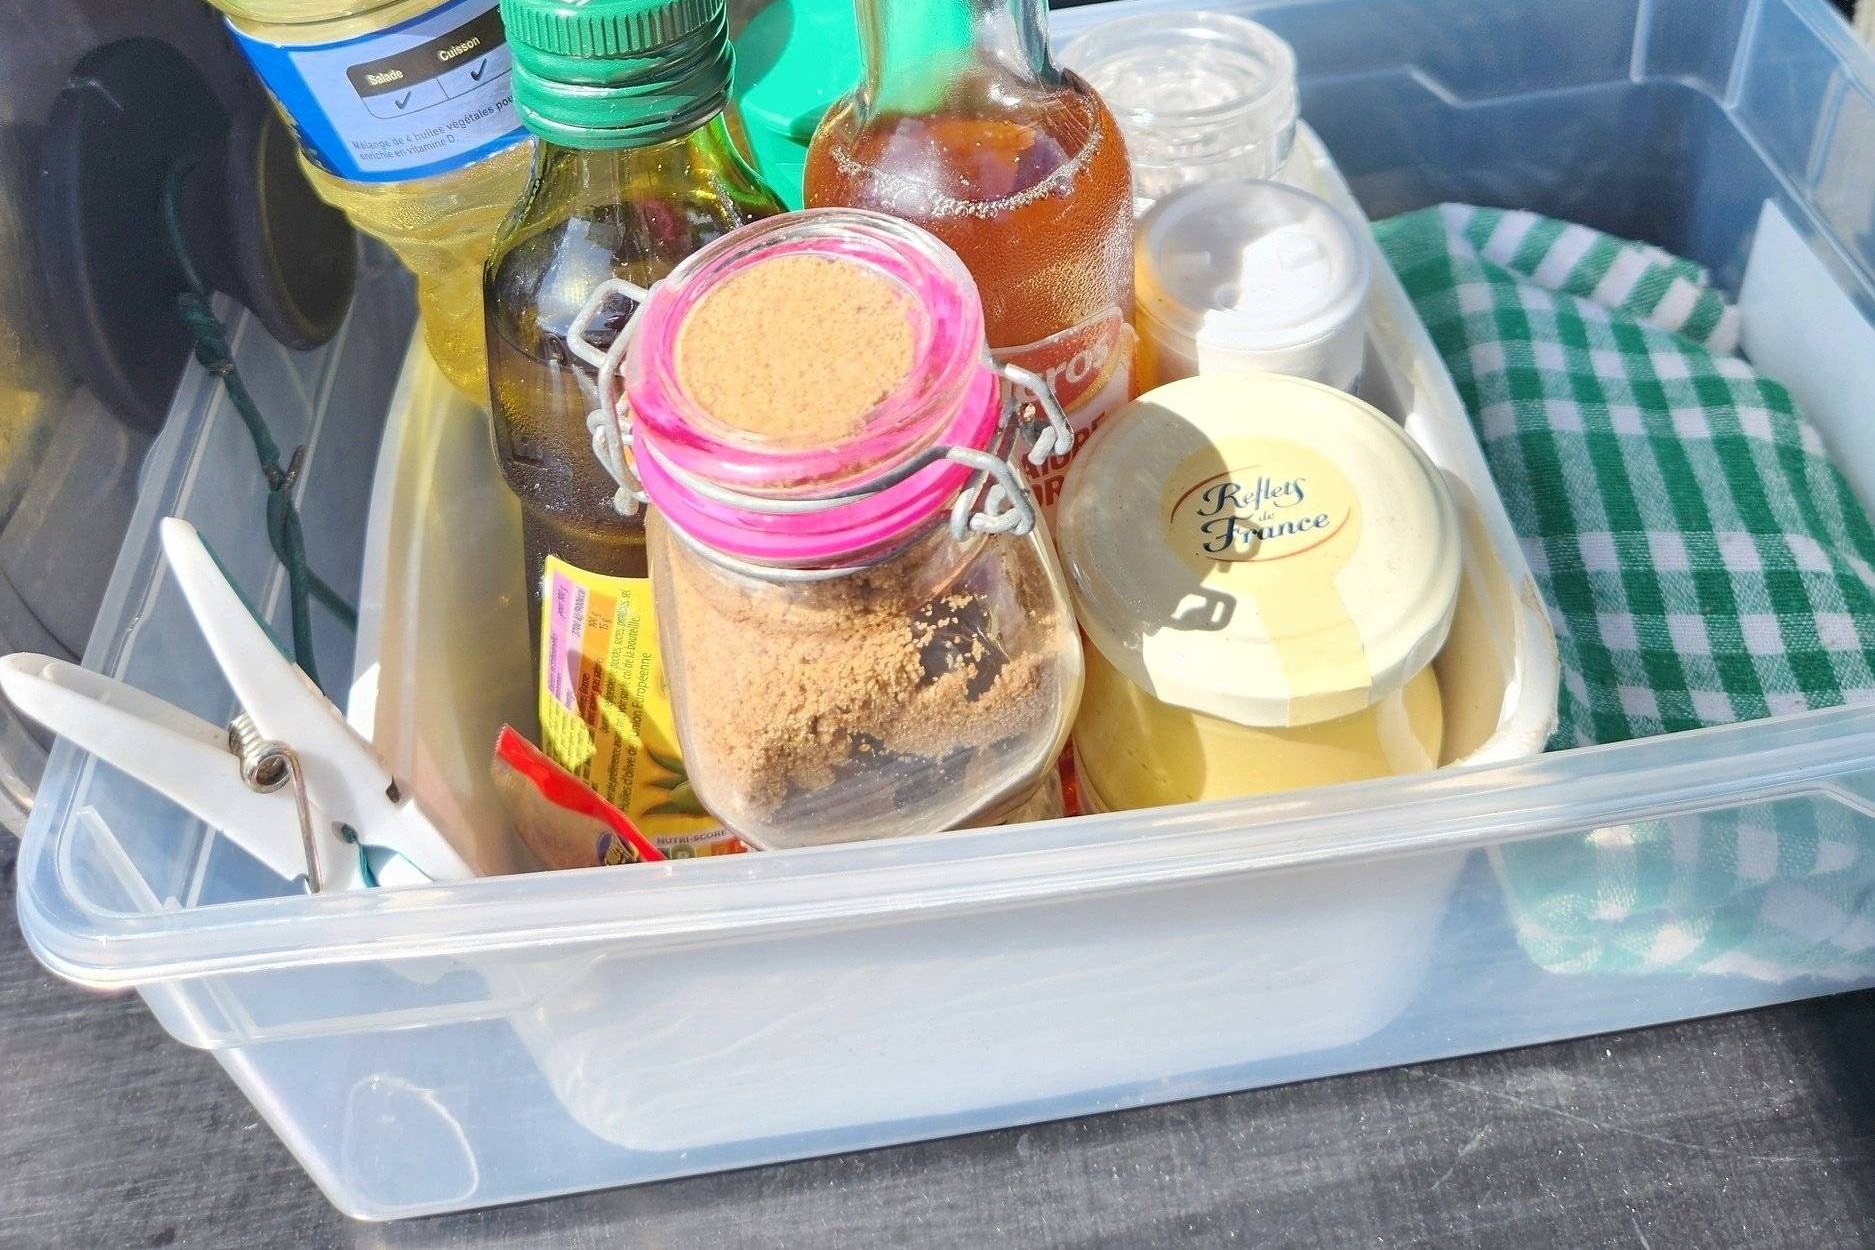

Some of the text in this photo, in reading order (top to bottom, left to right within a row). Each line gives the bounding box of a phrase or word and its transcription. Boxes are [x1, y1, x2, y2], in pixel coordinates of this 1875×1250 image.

[366, 36, 481, 87] Salade Cuisson
[414, 125, 446, 141] huiles
[446, 106, 495, 132] végétales
[496, 95, 514, 113] pou
[360, 150, 394, 161] enrichie
[407, 138, 446, 156] vitamine
[1197, 477, 1306, 516] Reflets
[1258, 510, 1274, 522] de
[1200, 512, 1330, 553] France
